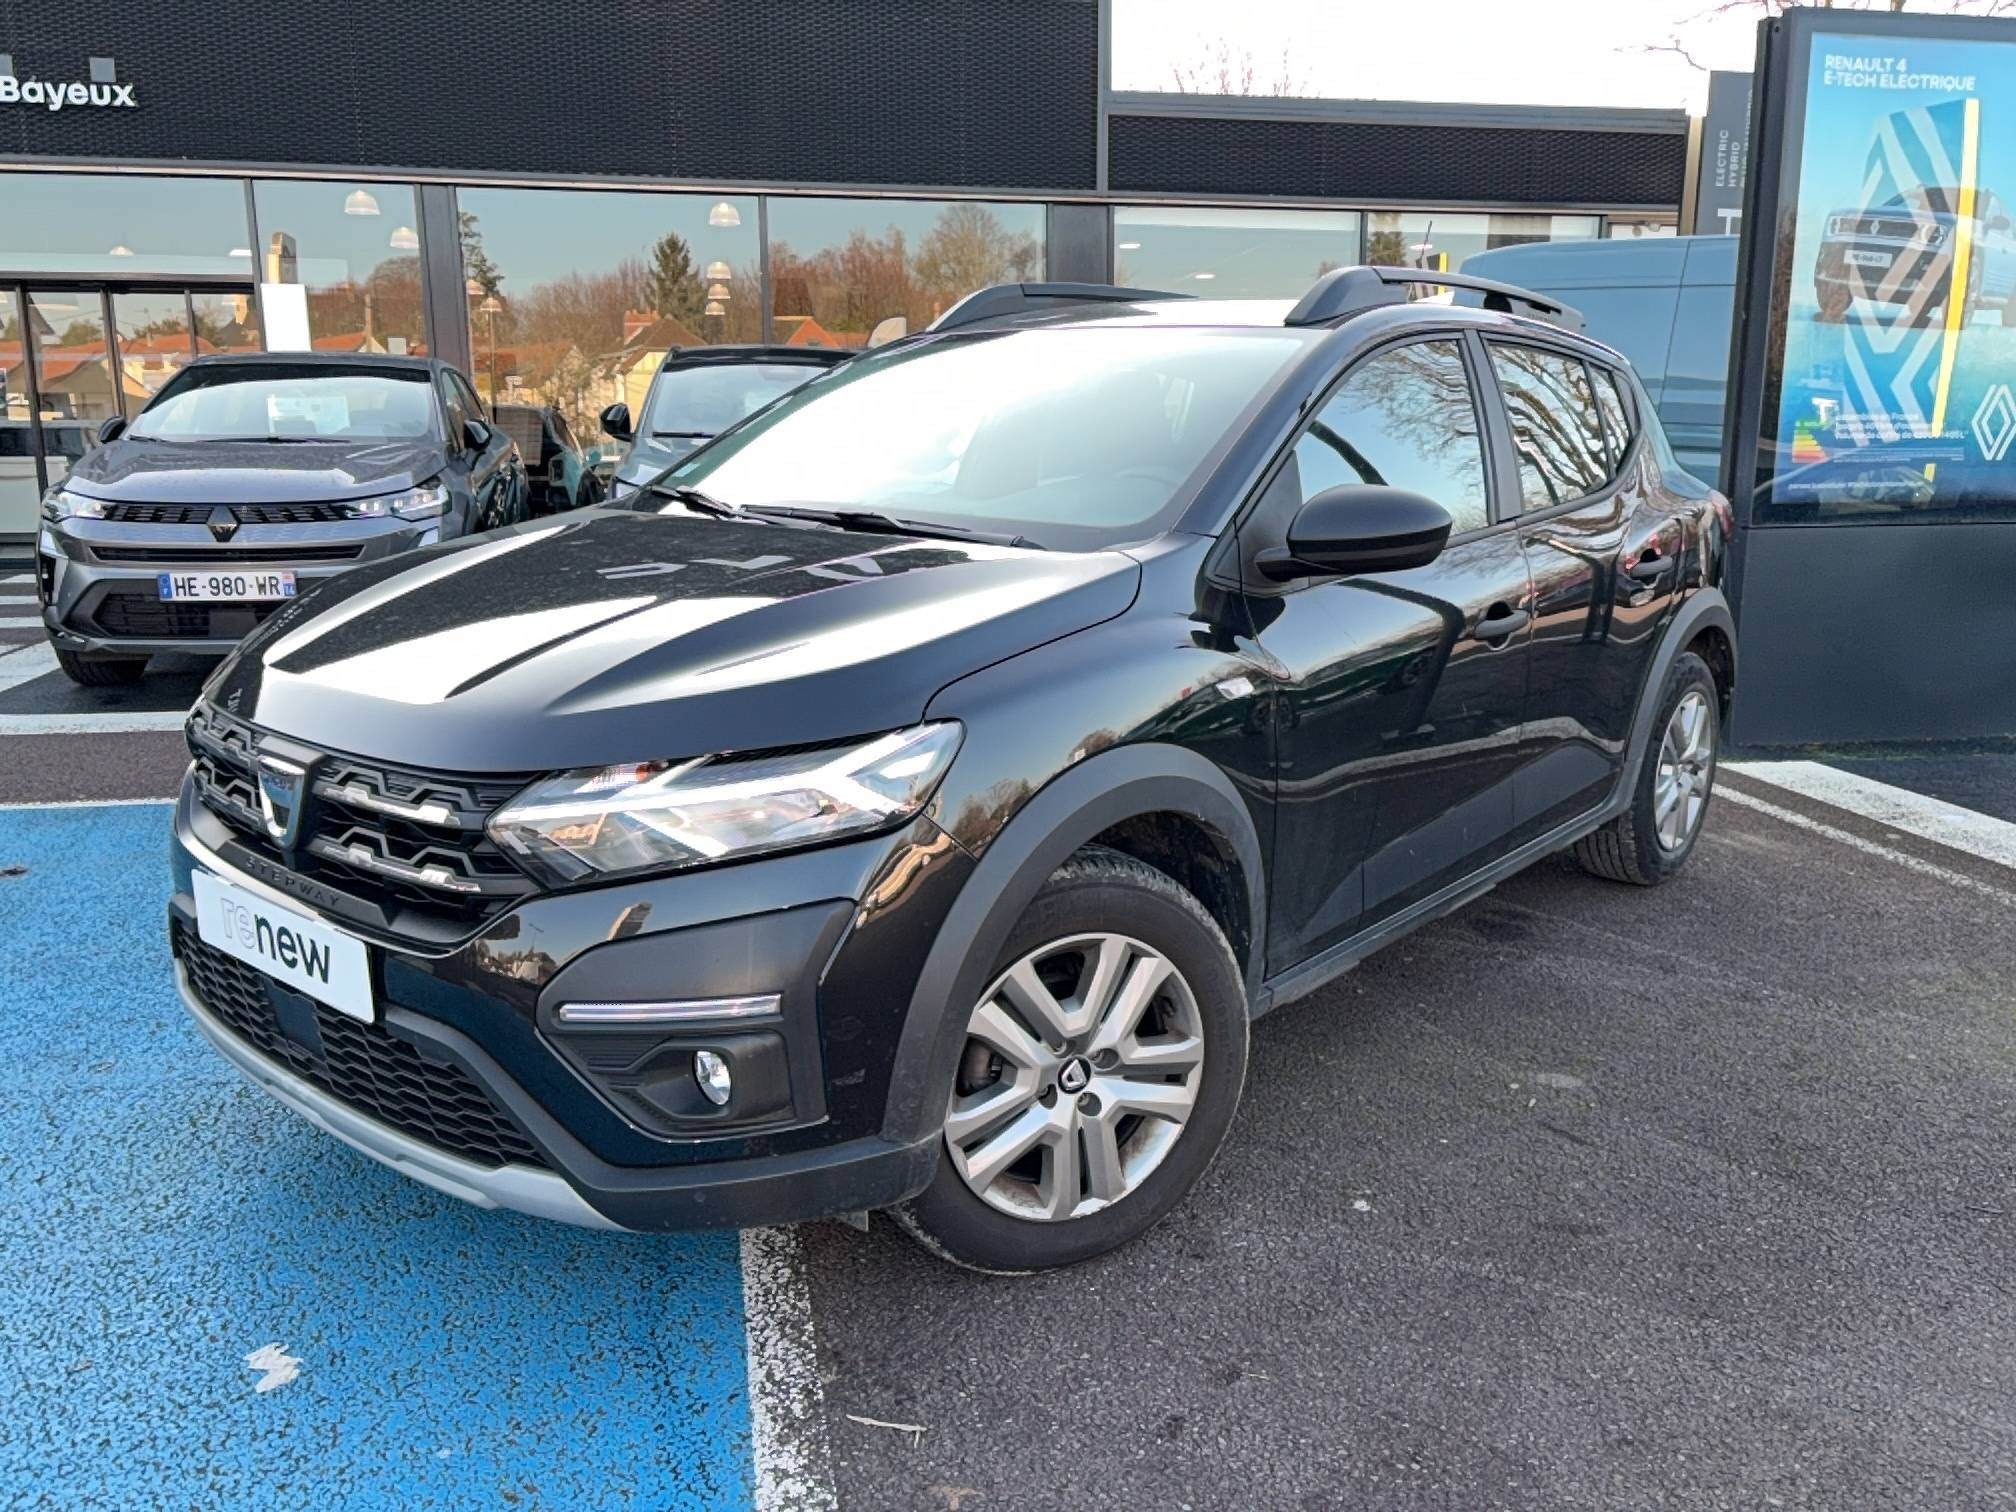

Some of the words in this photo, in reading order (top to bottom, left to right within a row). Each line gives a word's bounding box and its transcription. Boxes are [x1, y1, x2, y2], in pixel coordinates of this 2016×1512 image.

[1824, 71, 1876, 88] E-TECH
[1825, 54, 1893, 72] RENAULT
[1896, 58, 1907, 73] 4
[0, 75, 137, 111] Bayeux
[1715, 129, 1729, 187] ELECTRIC
[1728, 142, 1741, 187] HYBRID
[174, 576, 281, 597] HE-980-WR
[246, 856, 340, 906] STEPWAY
[221, 897, 330, 984] renew
